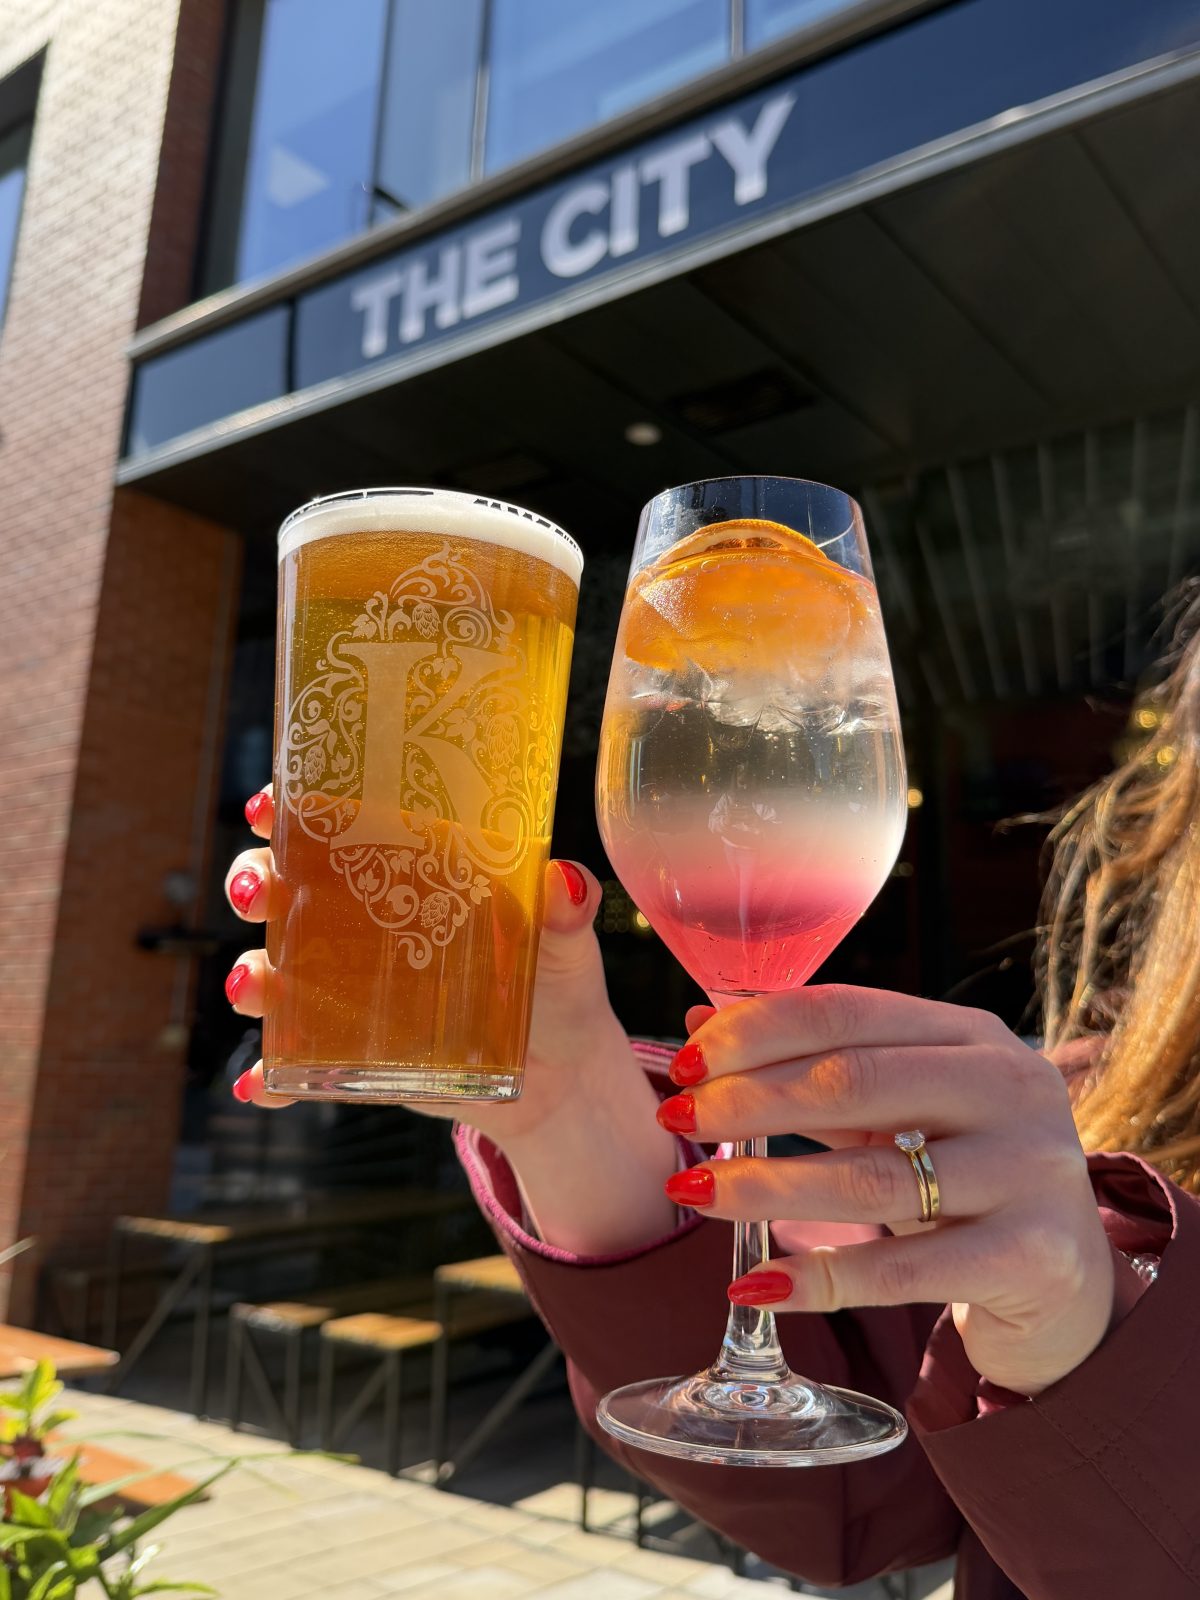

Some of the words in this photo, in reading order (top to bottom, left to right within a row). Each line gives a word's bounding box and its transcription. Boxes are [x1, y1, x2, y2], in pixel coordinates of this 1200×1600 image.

[352, 219, 522, 359] THE
[540, 93, 796, 279] CITY
[329, 640, 526, 868] K
